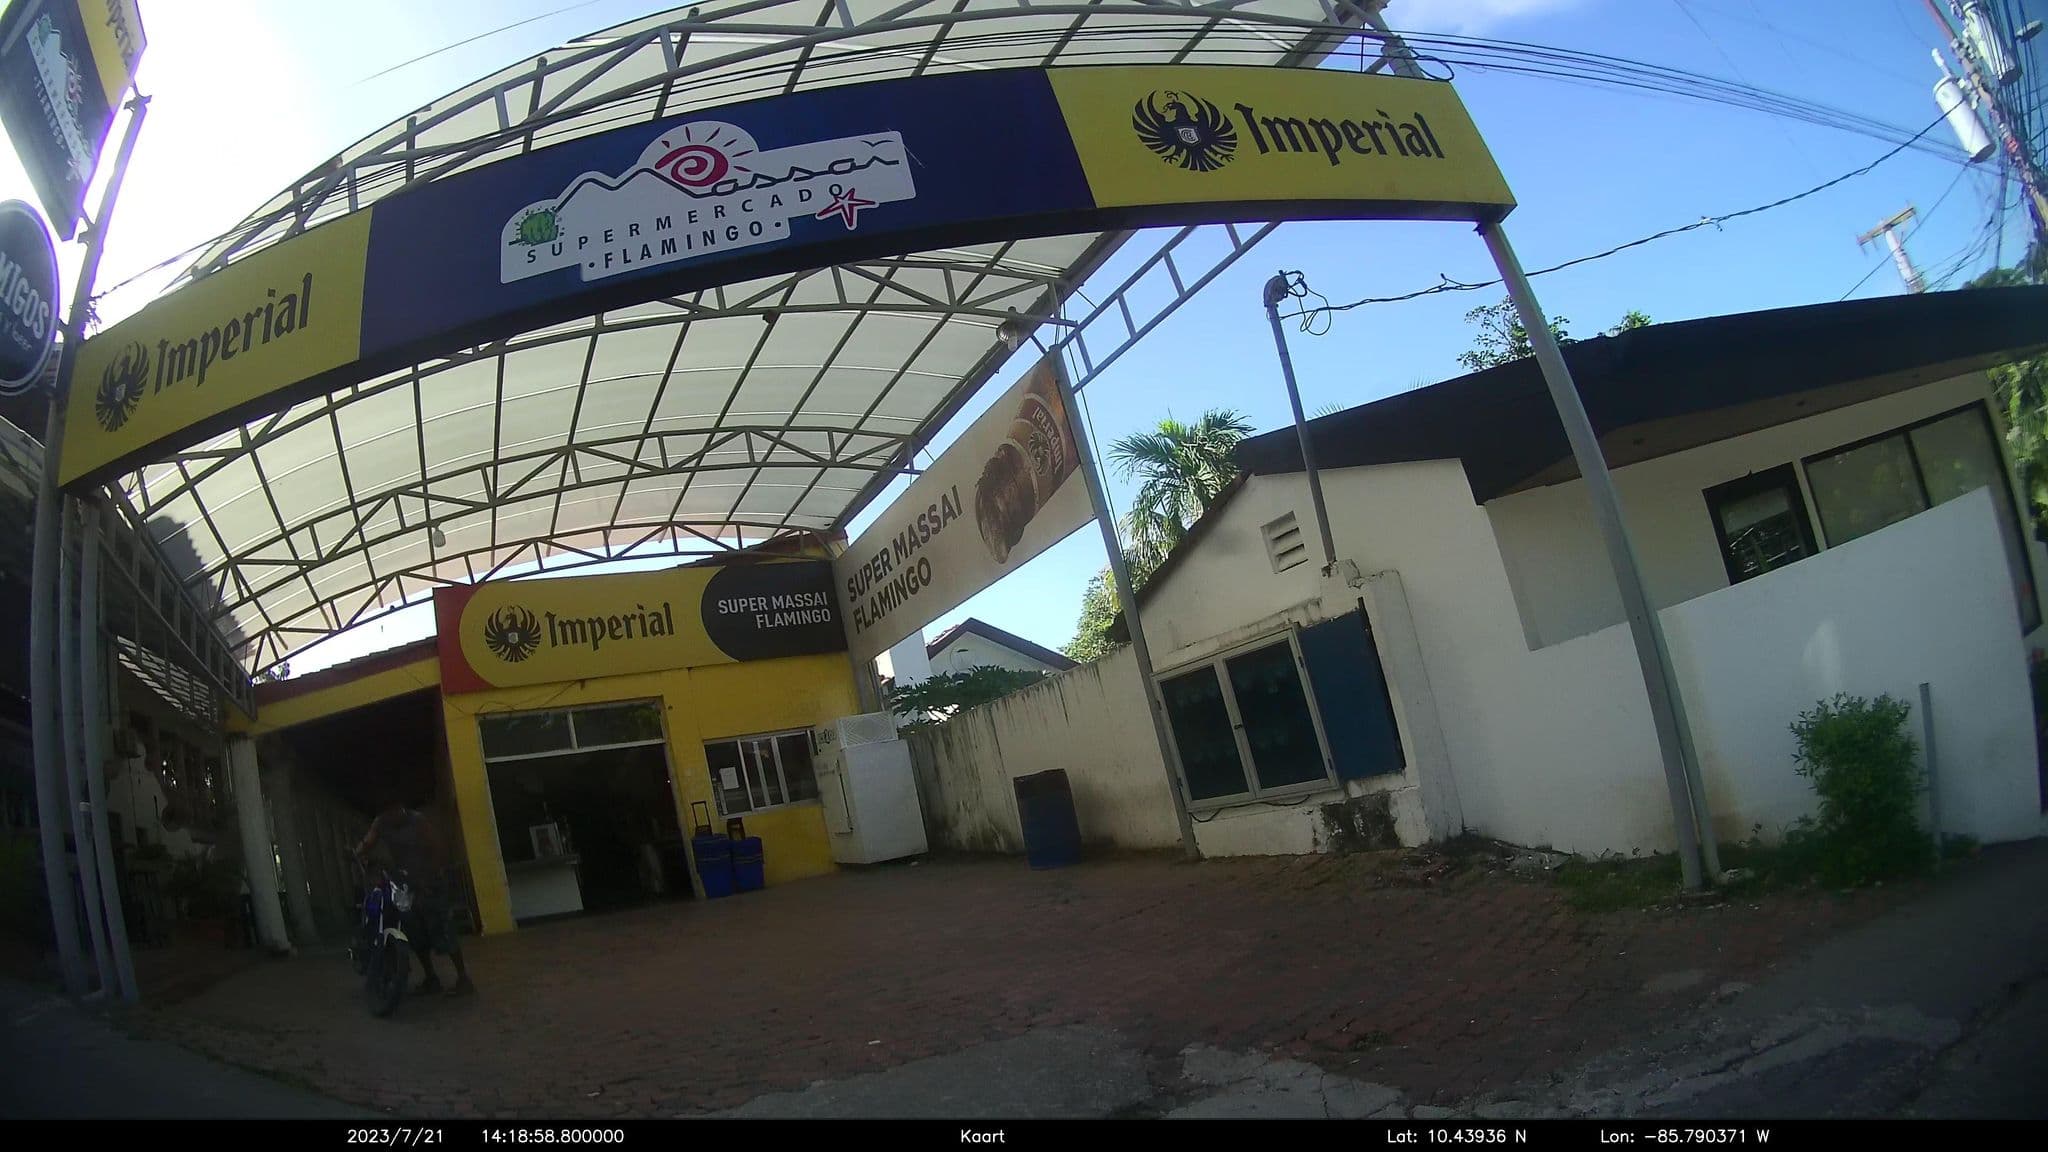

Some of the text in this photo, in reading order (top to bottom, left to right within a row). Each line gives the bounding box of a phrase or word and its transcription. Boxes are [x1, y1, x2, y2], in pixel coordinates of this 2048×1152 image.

[1234, 102, 1445, 166] Imperial
[527, 183, 844, 264] SUPERMERCADO
[604, 220, 763, 269] FLAMINGO
[153, 272, 313, 396] Imperial
[1032, 406, 1064, 475] Imperial
[847, 484, 963, 603] SUPER MASSAI
[545, 602, 675, 651] Imperial
[718, 591, 828, 614] SUPER MASSAI
[755, 608, 831, 629] FLAMINGO
[852, 556, 932, 635] FLAMINGO
